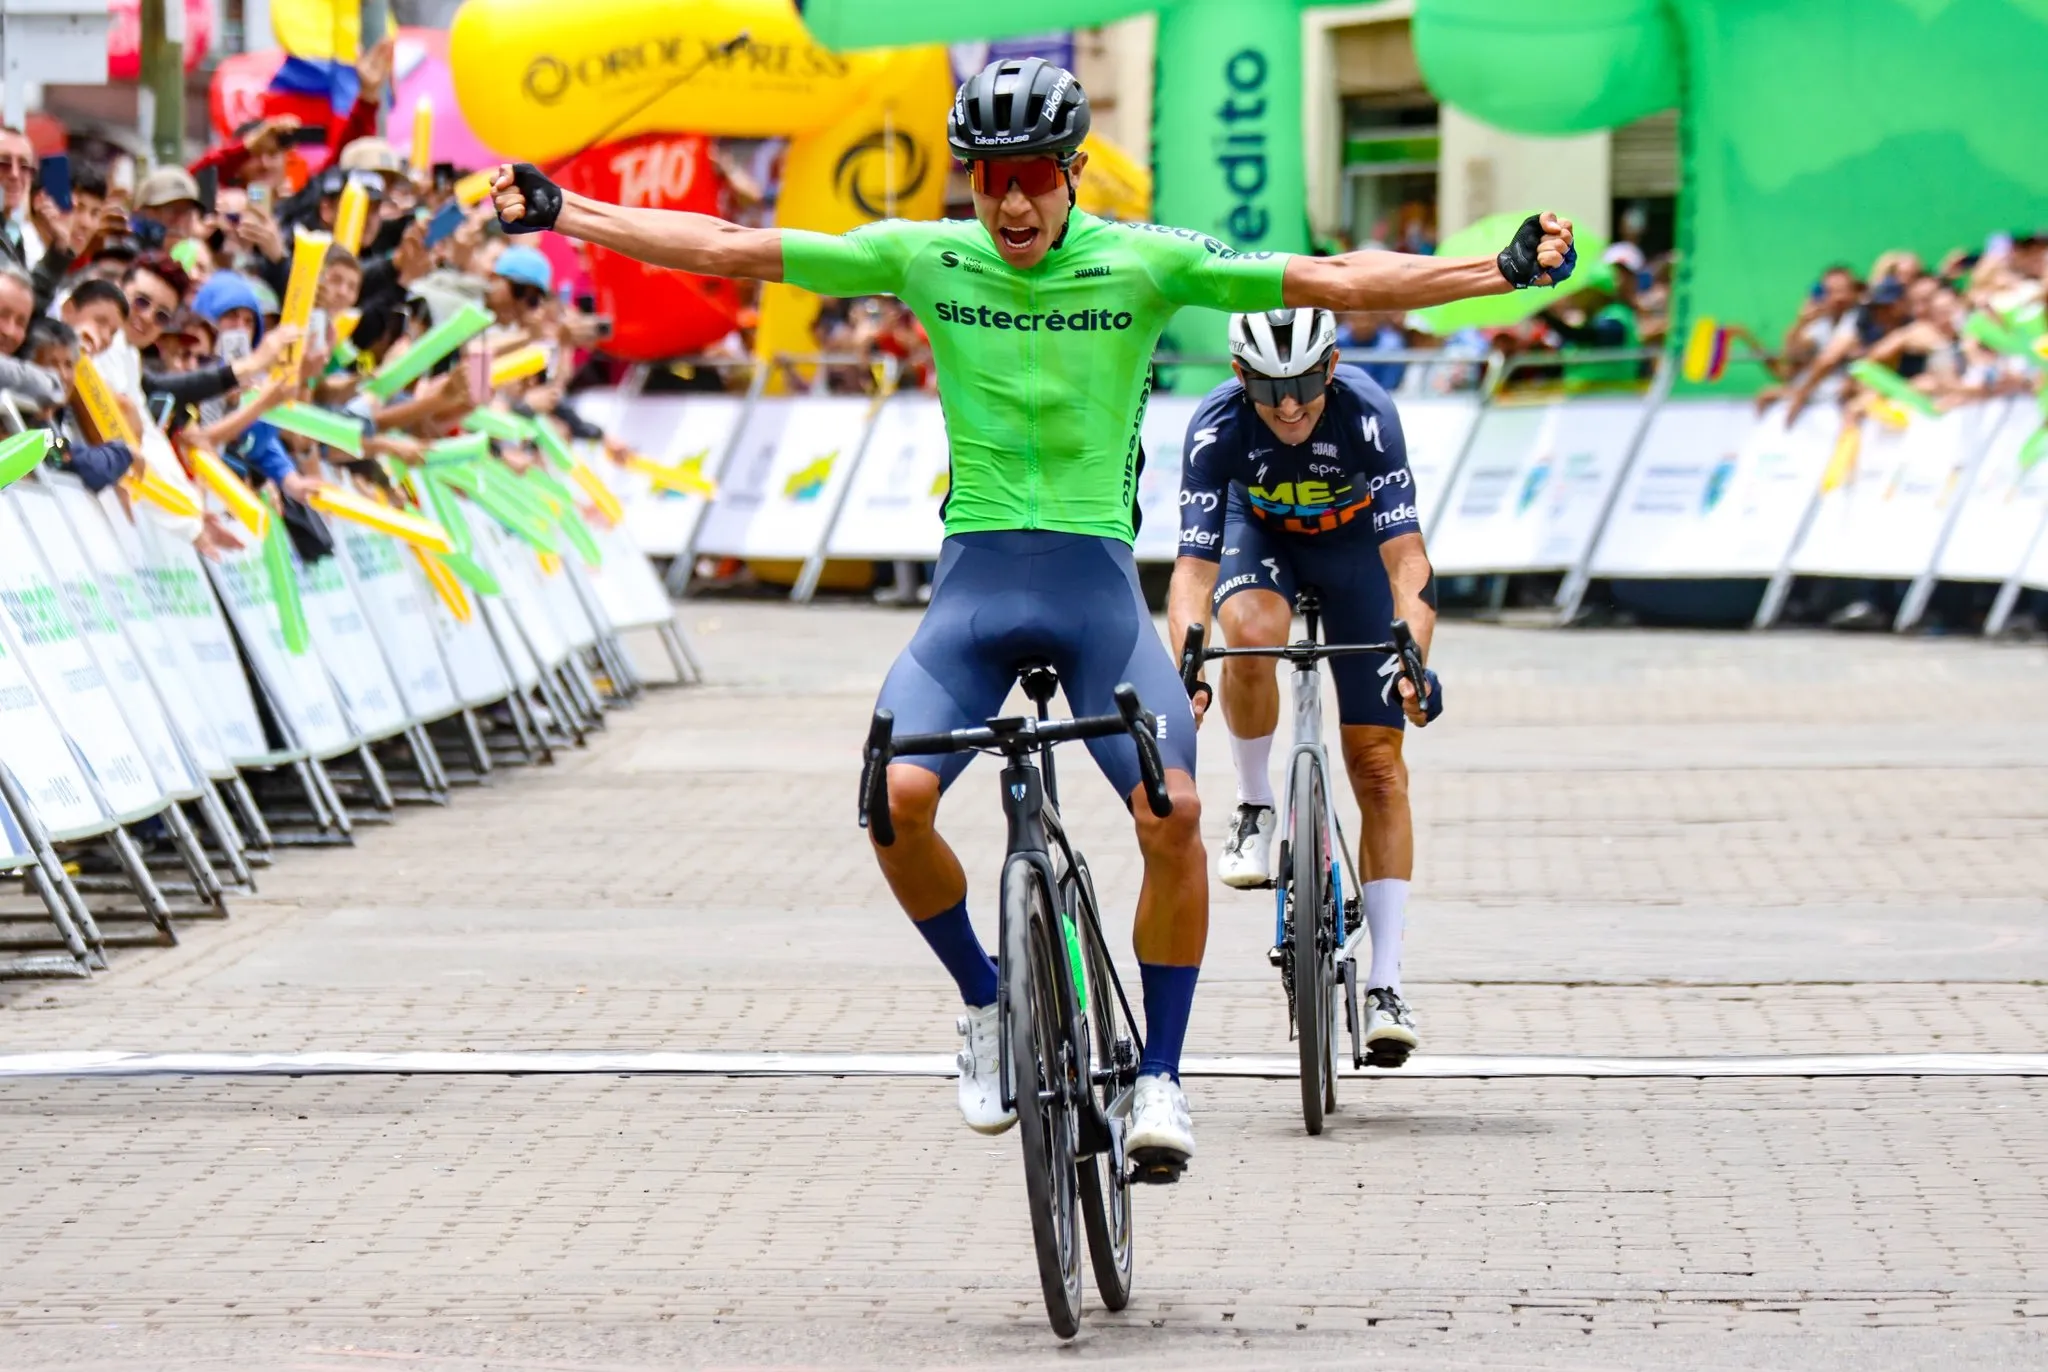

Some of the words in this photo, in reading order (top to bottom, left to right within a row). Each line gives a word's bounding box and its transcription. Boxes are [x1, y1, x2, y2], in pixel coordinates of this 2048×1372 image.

[975, 134, 1030, 145] bikehouse
[1074, 265, 1112, 279] SUAREZ
[935, 300, 1133, 332] sistecrédito
[1213, 574, 1259, 604] SUAREZ
